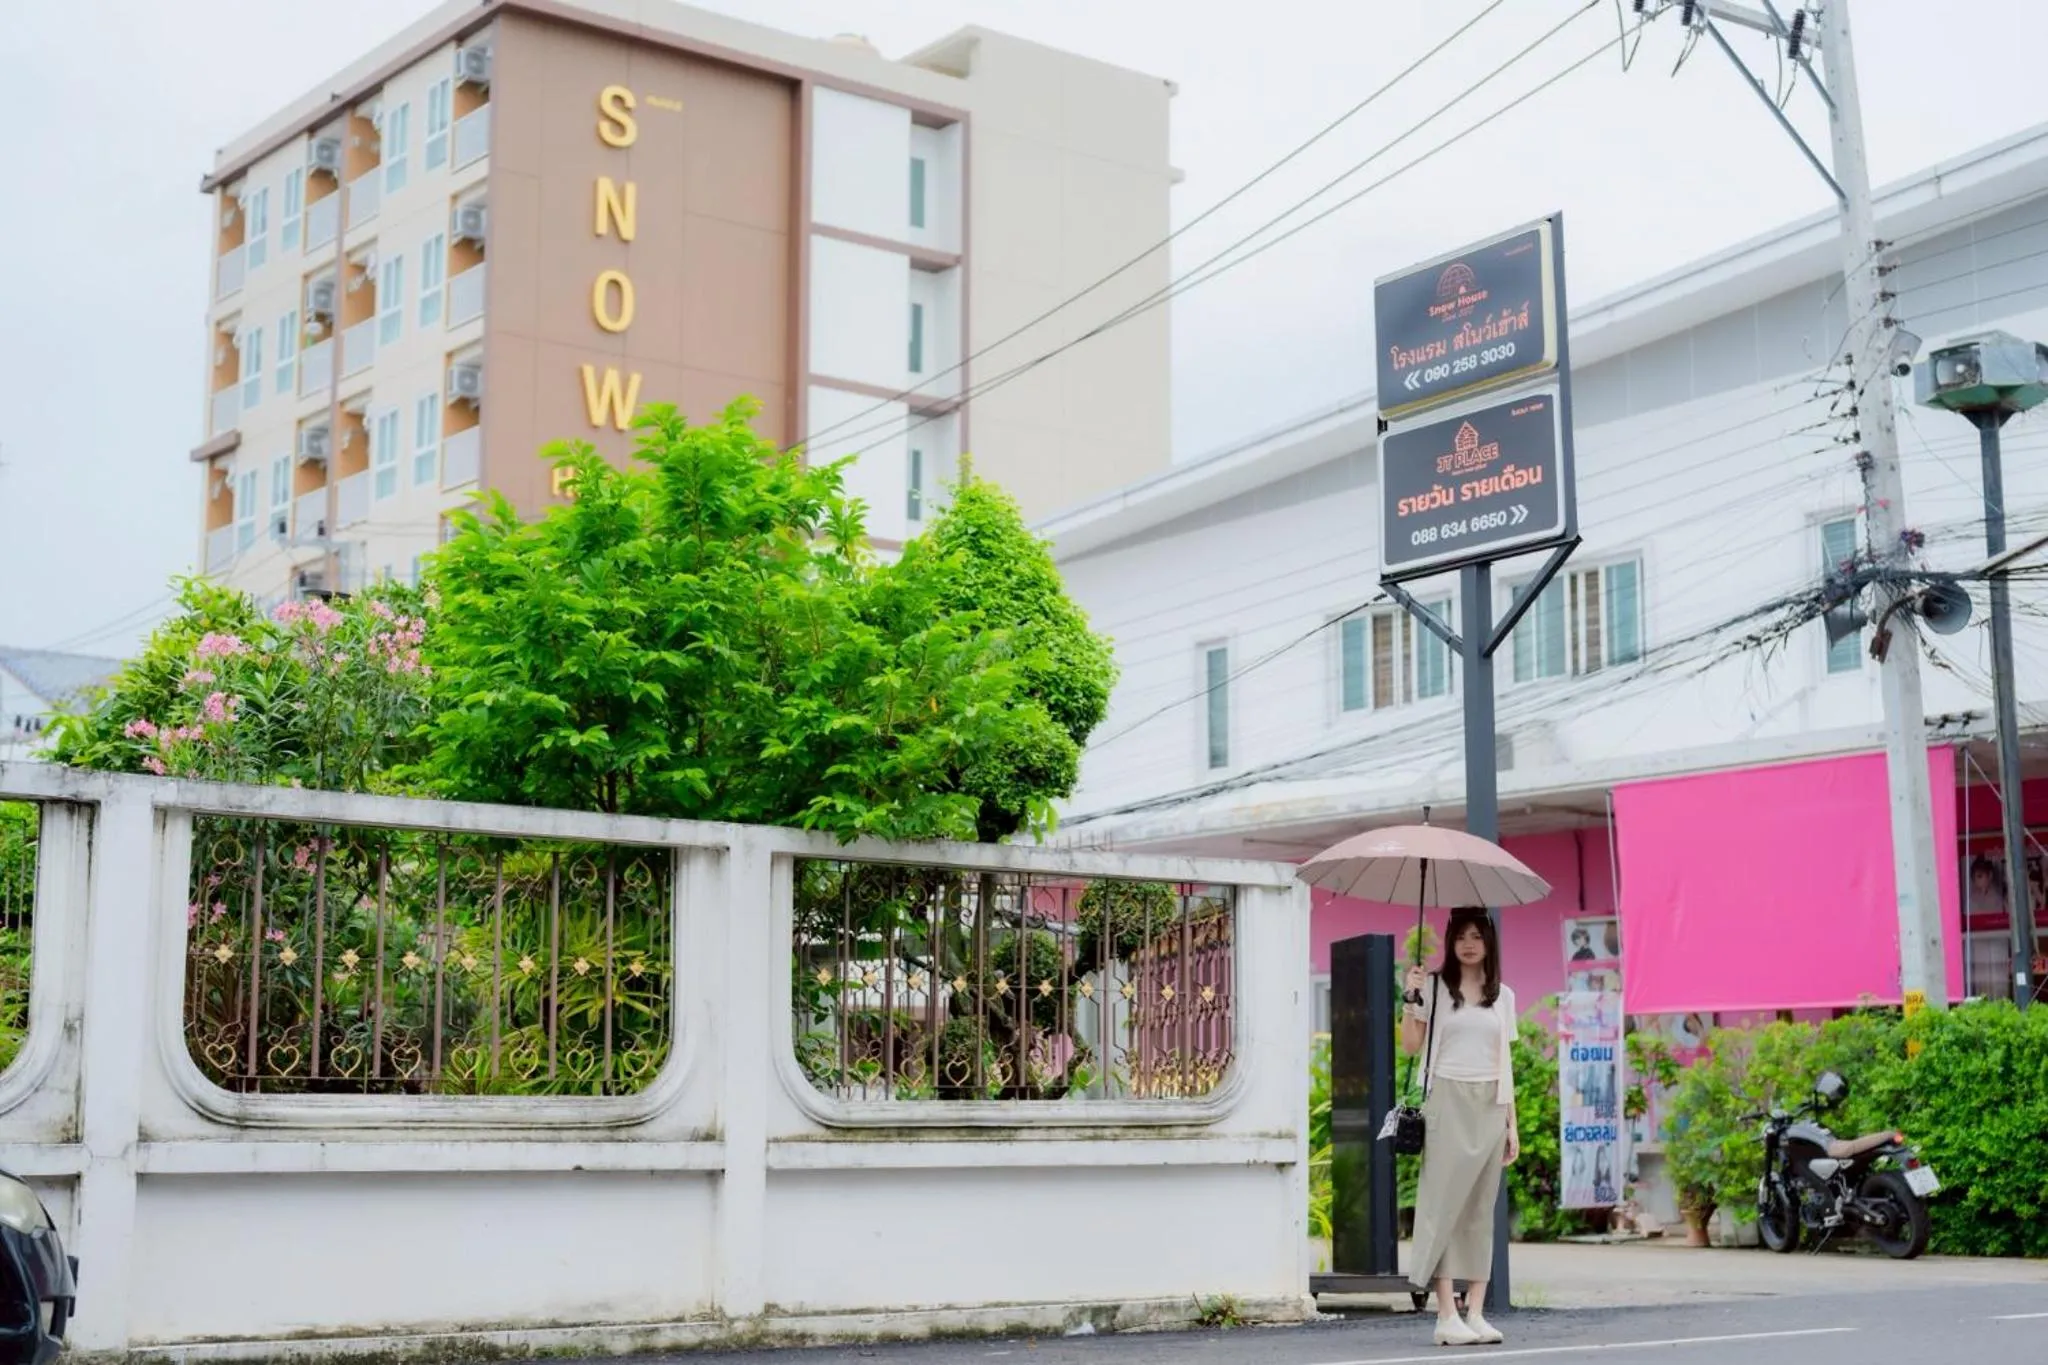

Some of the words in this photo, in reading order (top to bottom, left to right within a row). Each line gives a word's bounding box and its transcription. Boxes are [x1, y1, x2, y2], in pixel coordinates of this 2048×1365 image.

[581, 84, 642, 431] SNOW
[1390, 339, 1447, 370] โรงแรม
[1424, 363, 1450, 383] 090
[1452, 354, 1477, 375] 258
[1480, 342, 1516, 365] 3030
[1454, 442, 1499, 468] PLACE
[1397, 483, 1455, 517] รายวัน
[1460, 463, 1543, 502] รายเดือน
[1411, 526, 1438, 546] 088
[1440, 519, 1467, 539] 634
[1470, 510, 1507, 532] 6650
